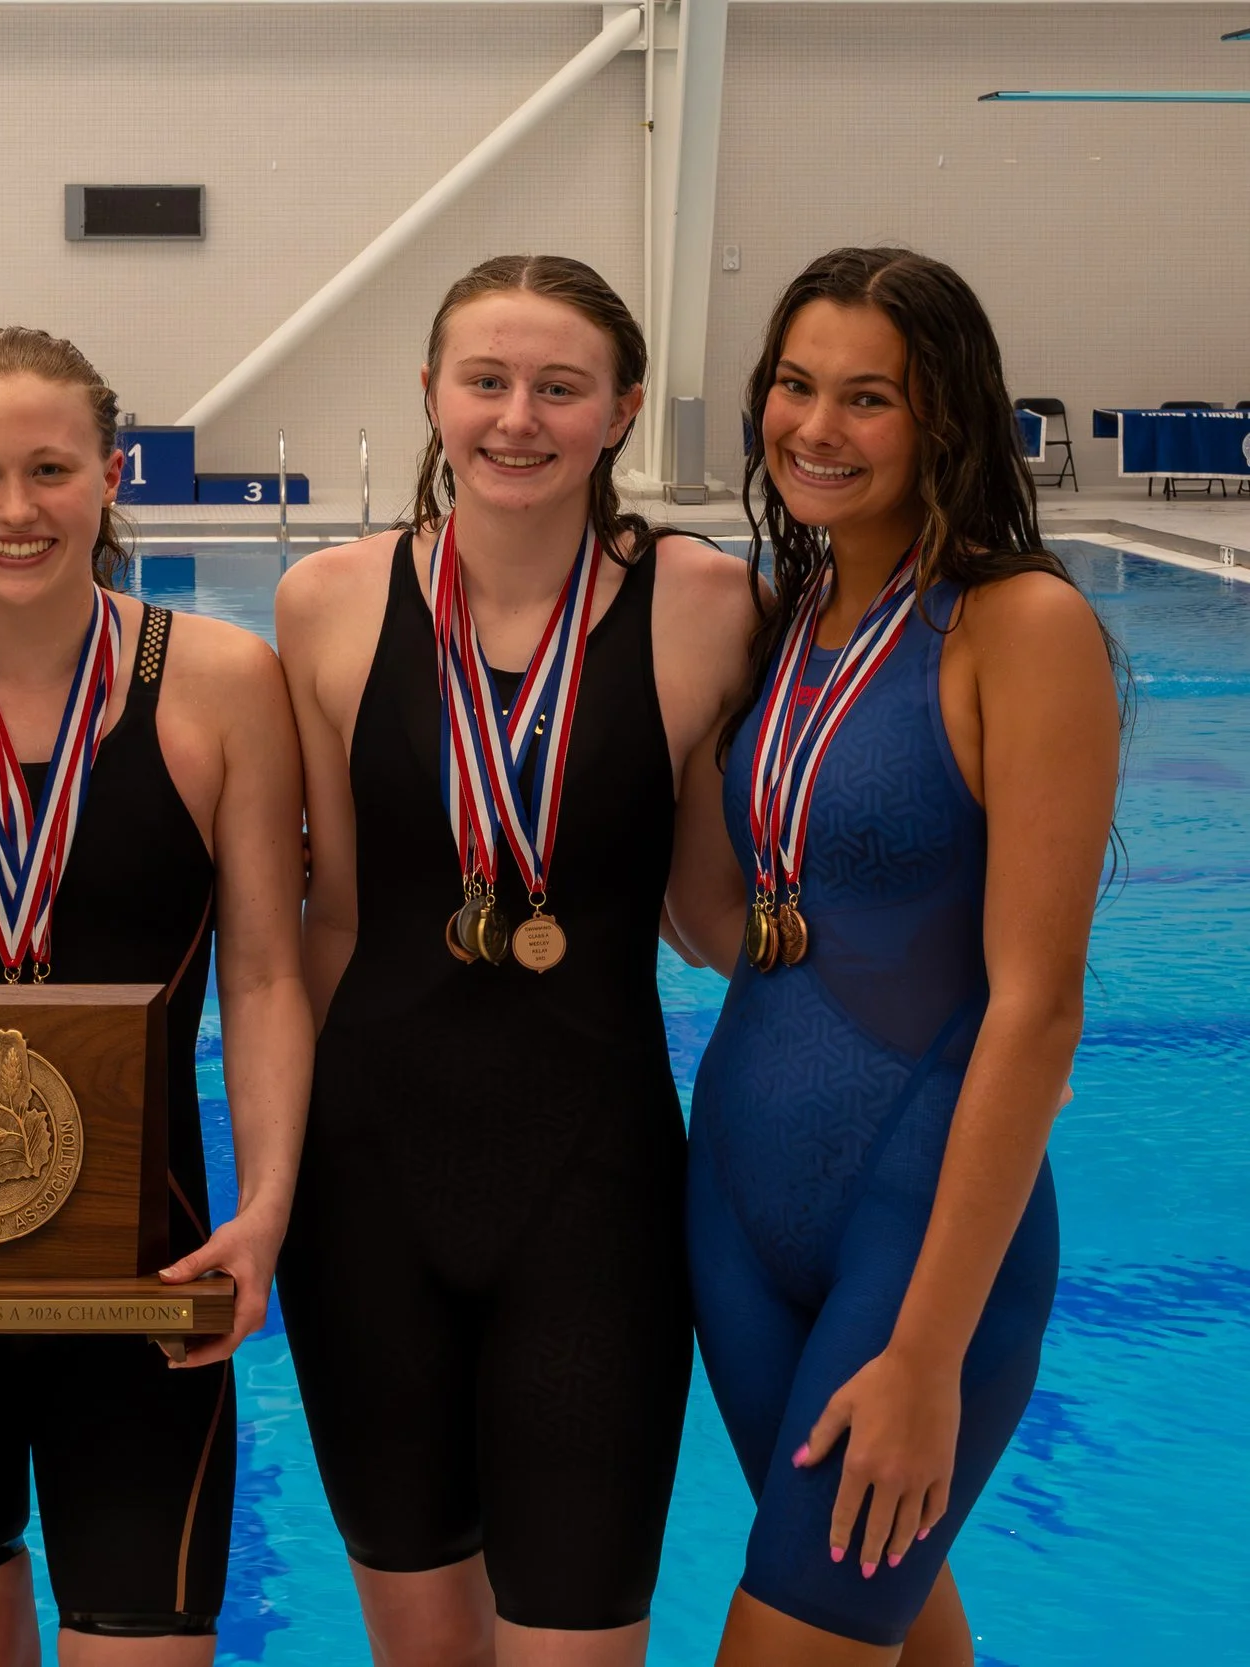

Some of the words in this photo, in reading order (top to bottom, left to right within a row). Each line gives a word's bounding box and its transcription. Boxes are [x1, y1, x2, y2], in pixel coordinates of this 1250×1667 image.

[128, 443, 147, 485] 1
[244, 481, 263, 502] 3
[15, 1119, 75, 1230] ASSOCIATION
[9, 1306, 20, 1322] A
[27, 1306, 62, 1322] 2026
[67, 1306, 181, 1322] CHAMPIONS
